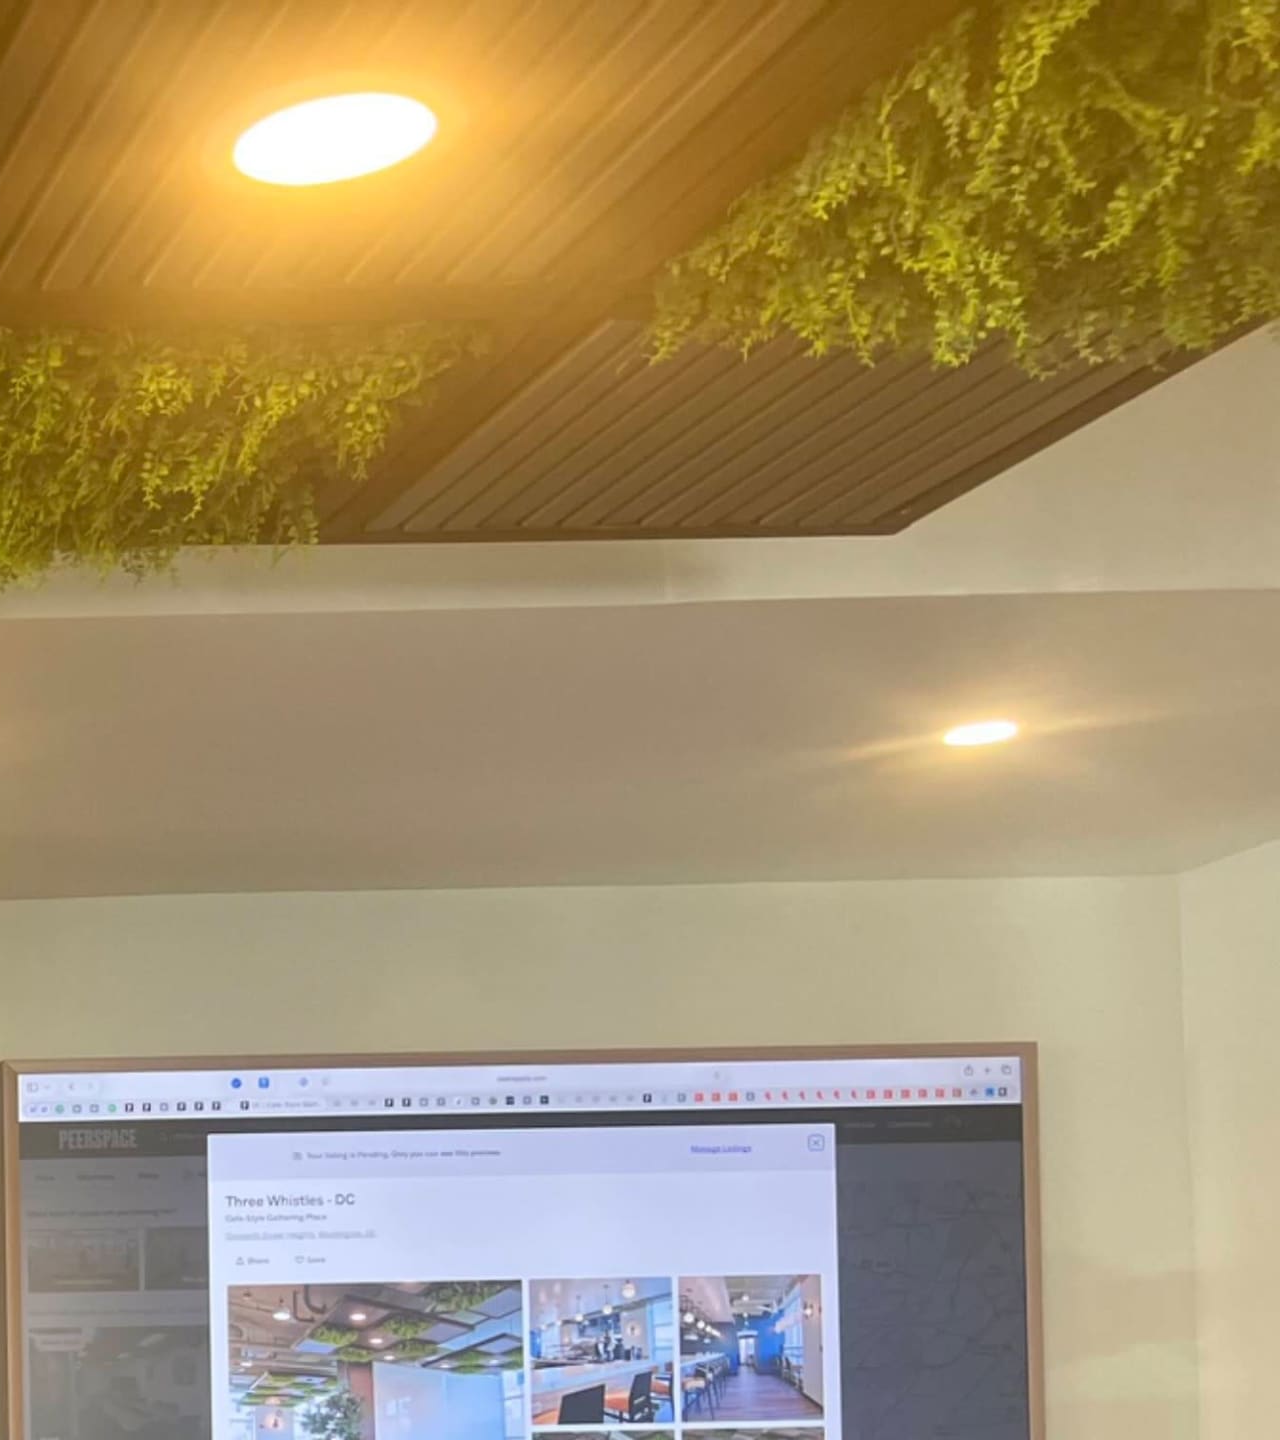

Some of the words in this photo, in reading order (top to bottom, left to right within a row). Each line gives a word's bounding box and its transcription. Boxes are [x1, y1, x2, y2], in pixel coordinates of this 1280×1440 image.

[59, 1129, 137, 1150] PEERSPACE
[225, 1195, 264, 1208] Three
[267, 1194, 324, 1207] Whistles
[334, 1193, 355, 1206] DC
